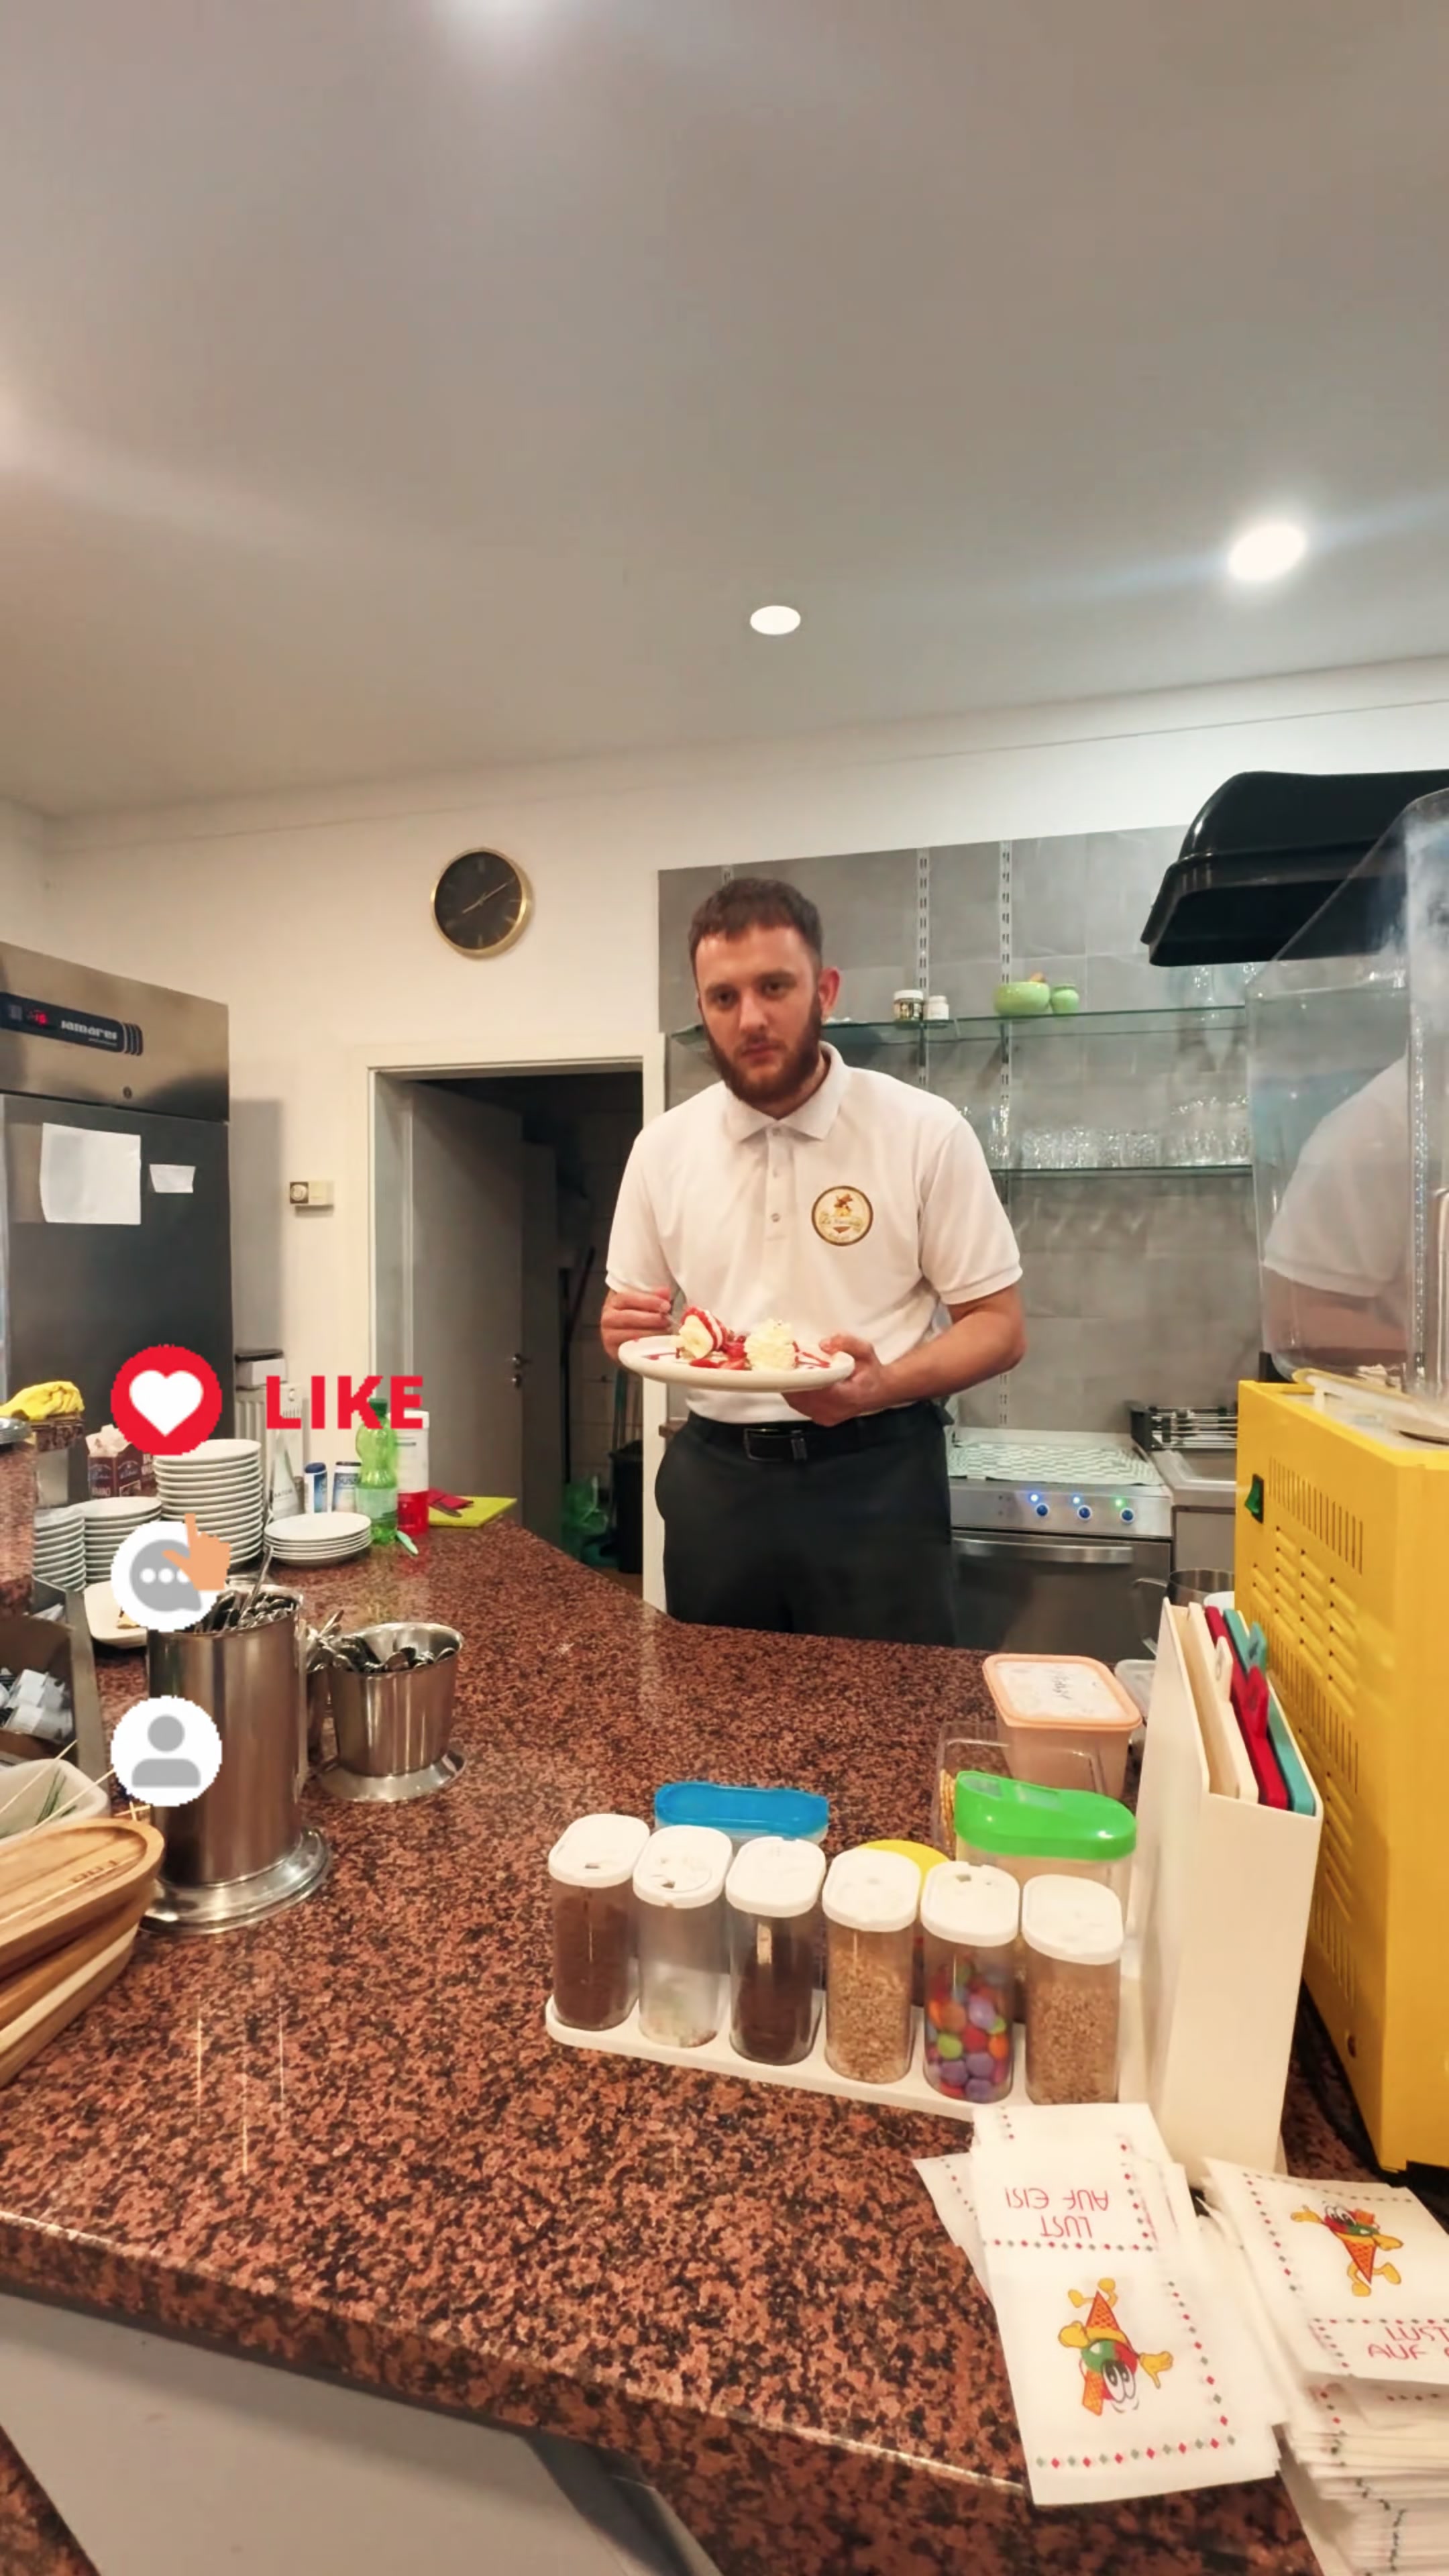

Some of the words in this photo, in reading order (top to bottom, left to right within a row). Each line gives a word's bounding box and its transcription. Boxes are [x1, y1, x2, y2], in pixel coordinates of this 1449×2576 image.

[1063, 2190, 1108, 2211] AUF
[1040, 2215, 1092, 2238] LUST
[1385, 2326, 1449, 2341] LUST
[1368, 2343, 1428, 2360] AUF
